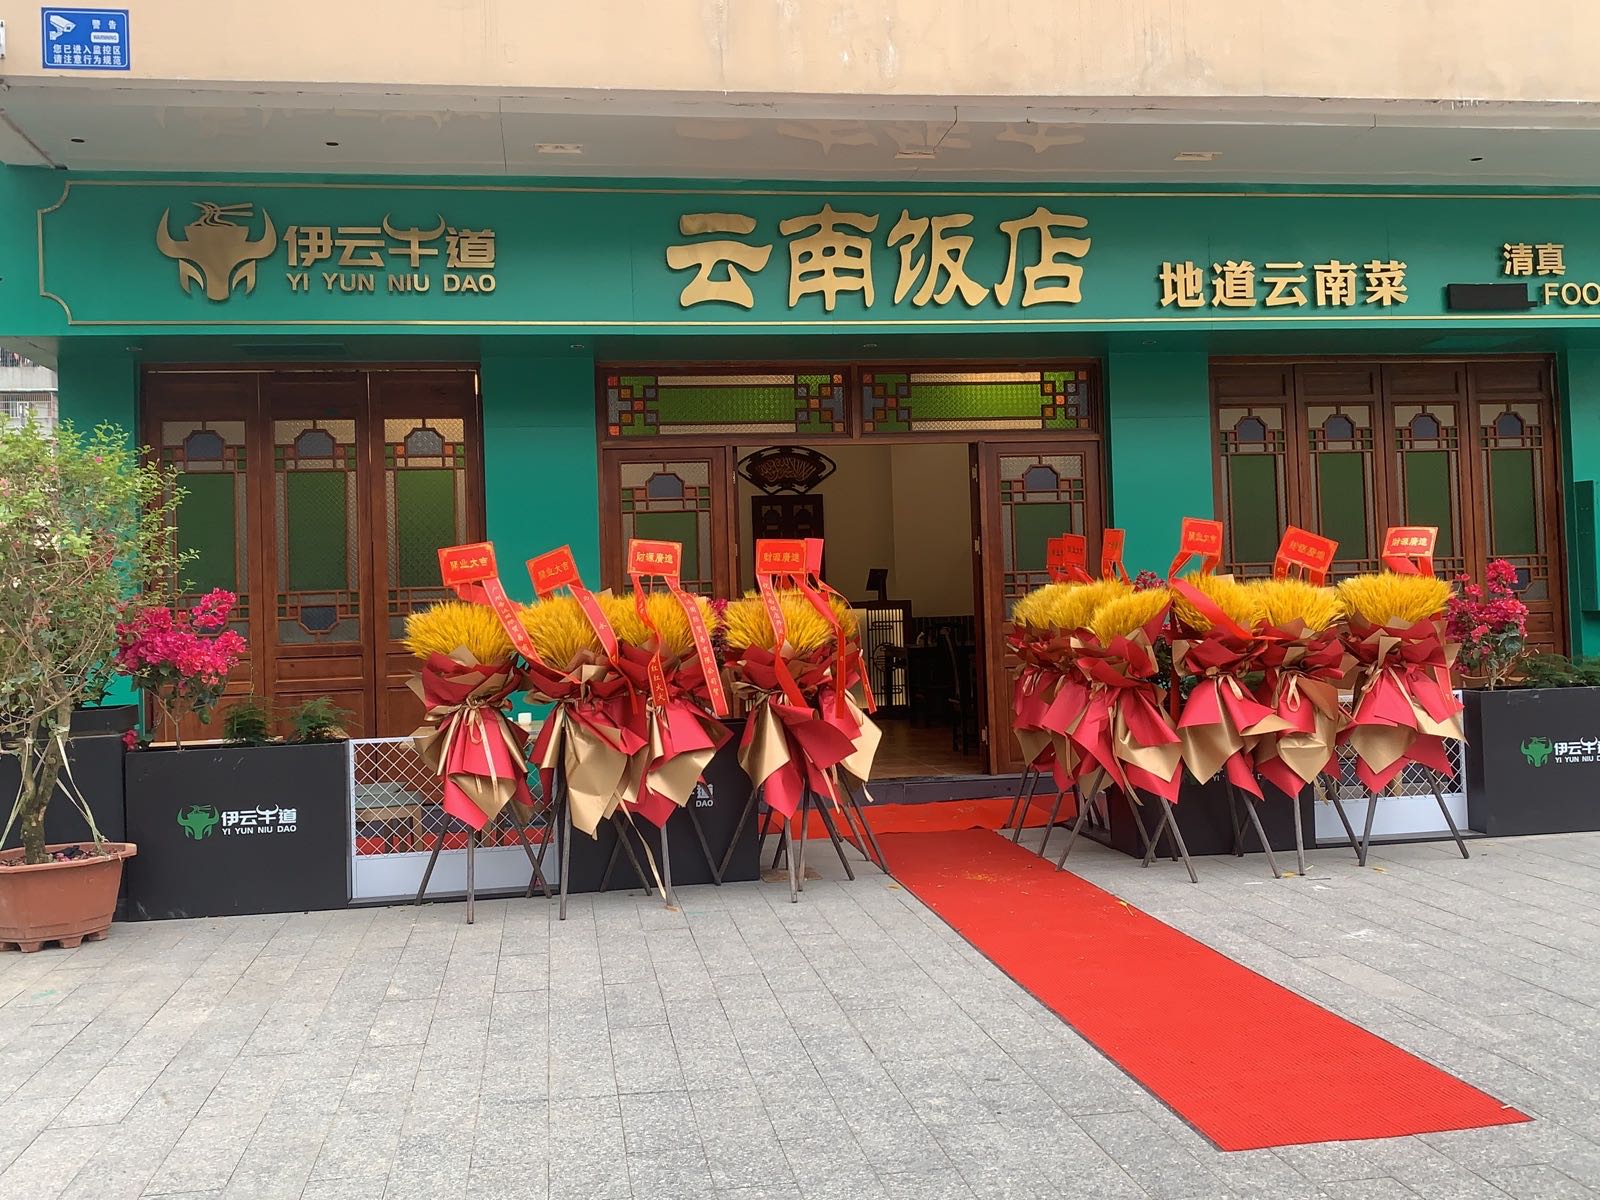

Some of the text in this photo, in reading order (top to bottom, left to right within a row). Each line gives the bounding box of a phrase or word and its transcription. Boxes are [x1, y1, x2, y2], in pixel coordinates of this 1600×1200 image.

[92, 19, 116, 29] 警告
[53, 44, 121, 55] 您已进入监控区
[53, 54, 122, 65] 请注意行为规范
[282, 211, 496, 269] 伊云牛道
[666, 202, 1092, 312] 云南饭店
[1503, 242, 1566, 276] 清真
[286, 273, 496, 293] YI YUN NIU DAO
[1159, 259, 1409, 308] 地道云南菜
[1554, 736, 1600, 756] 伊云牛
[696, 800, 713, 808] DAO
[221, 804, 297, 826] 伊云牛道
[222, 825, 297, 835] YI YUN NIU DAO
